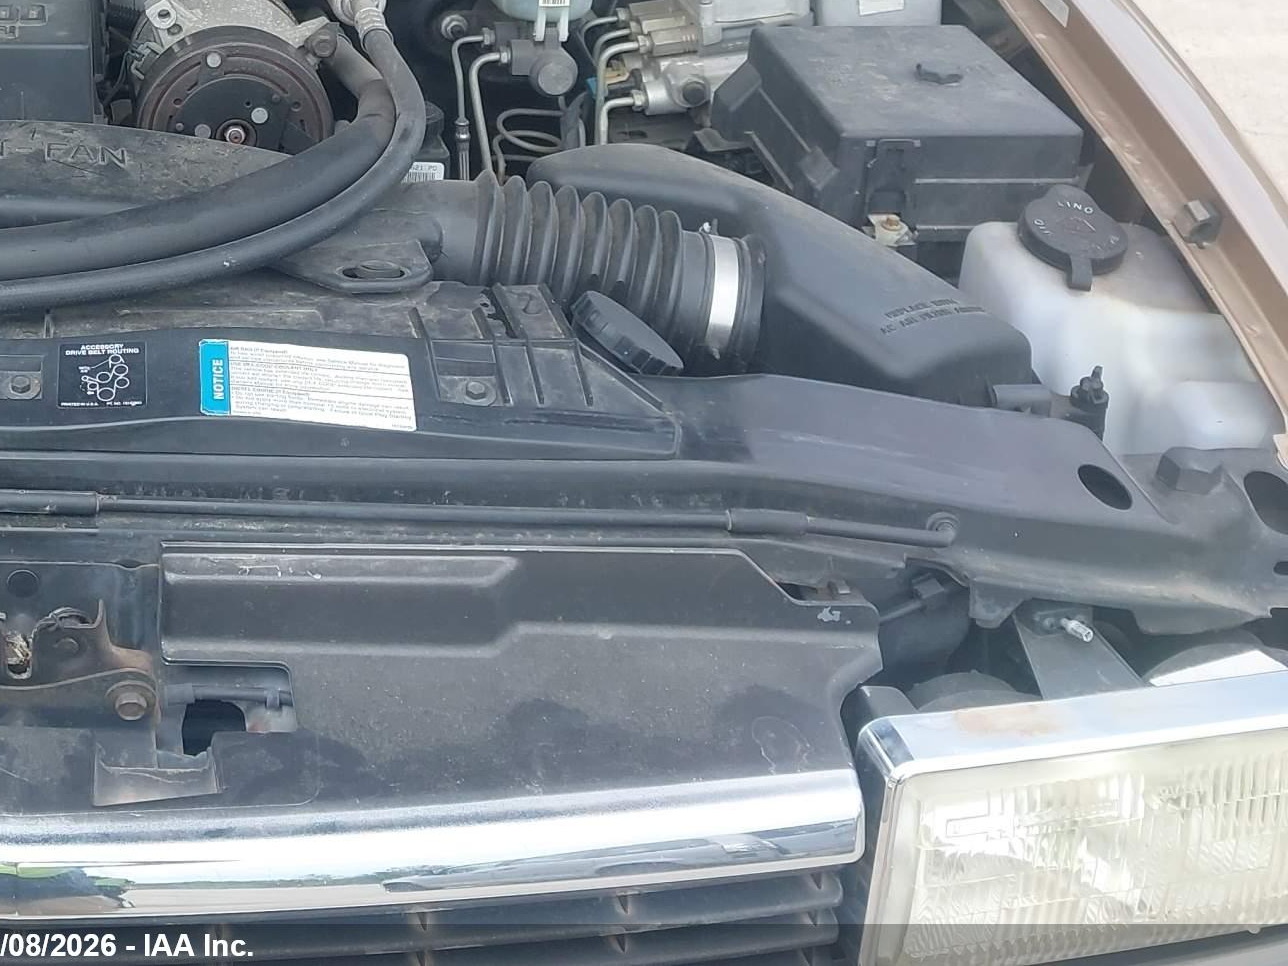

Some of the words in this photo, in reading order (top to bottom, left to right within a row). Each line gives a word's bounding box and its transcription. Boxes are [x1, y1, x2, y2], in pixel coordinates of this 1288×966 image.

[43, 141, 128, 167] FAN
[106, 347, 140, 355] ROUTING
[211, 358, 226, 401] NOTICE
